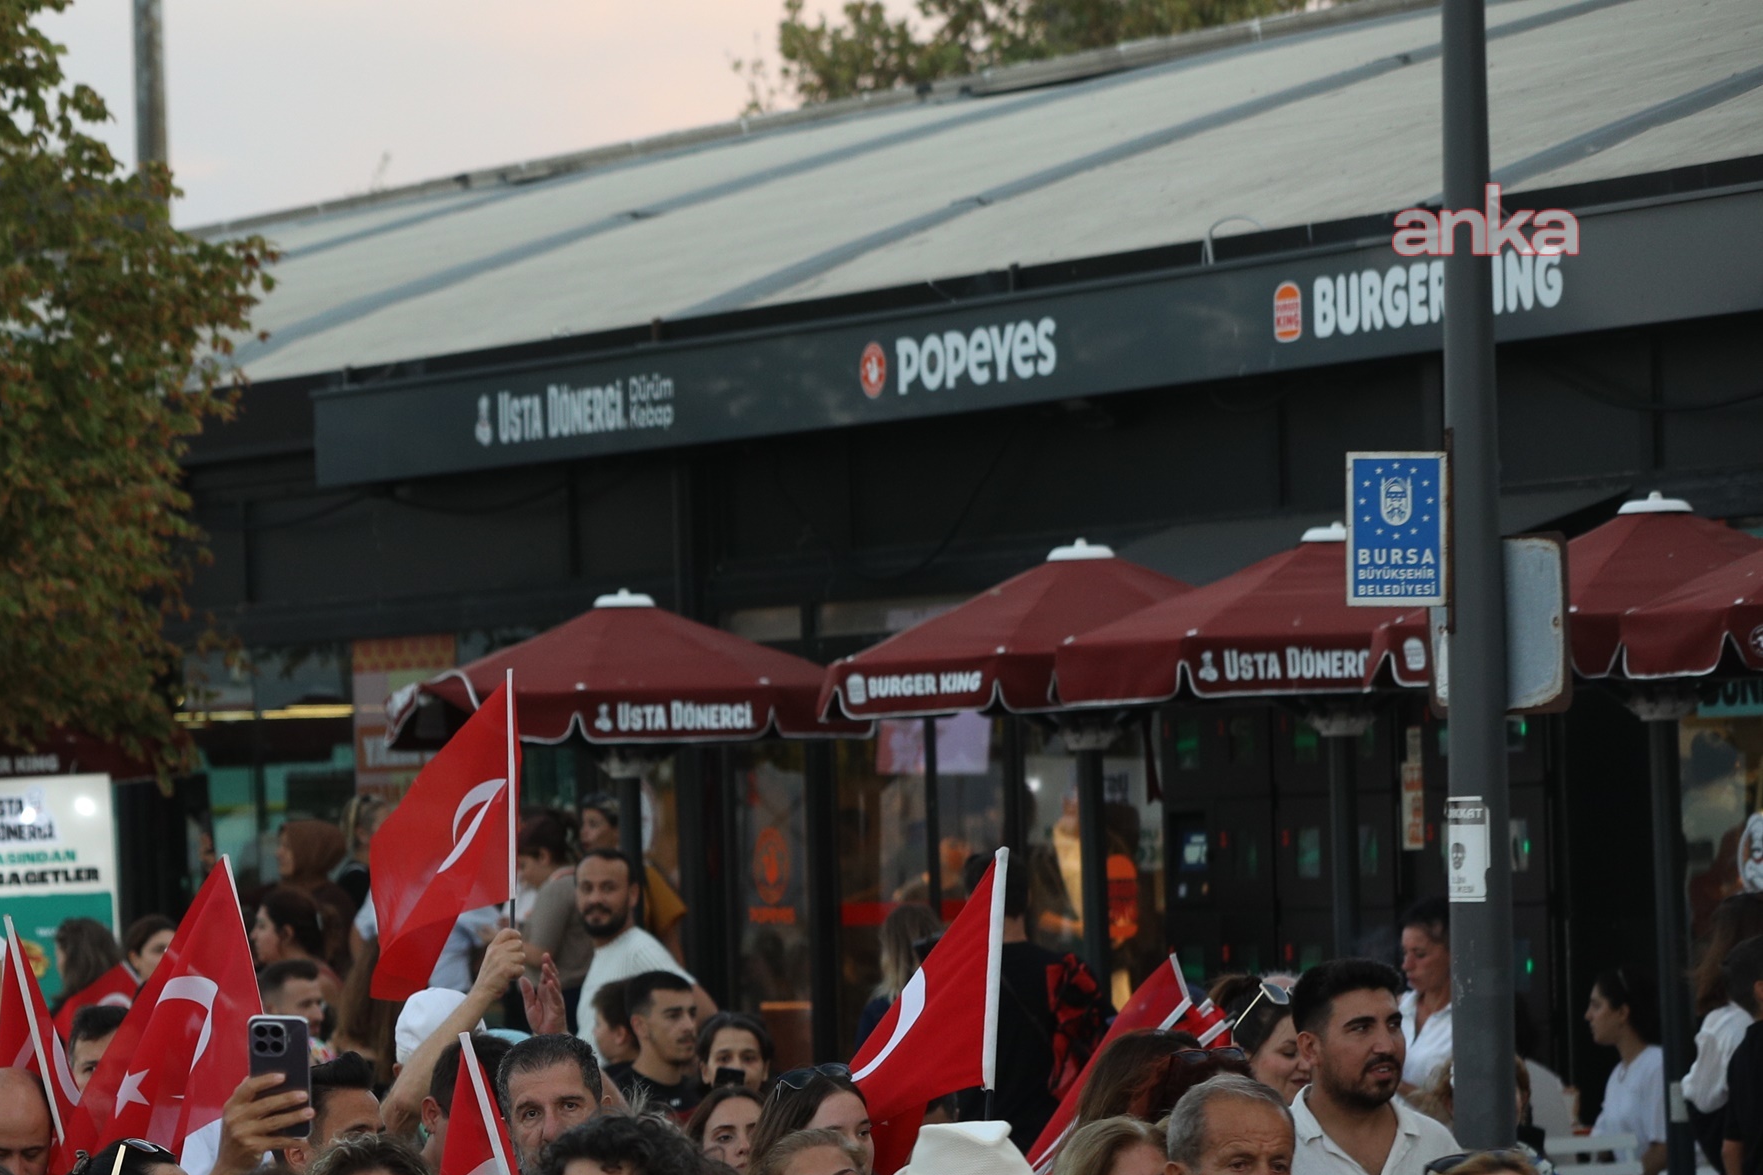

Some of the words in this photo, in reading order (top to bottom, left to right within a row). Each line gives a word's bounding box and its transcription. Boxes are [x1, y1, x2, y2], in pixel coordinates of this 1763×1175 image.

[1313, 264, 1445, 339] BURGER
[1491, 245, 1564, 316] ING
[629, 373, 674, 402] Dürüm
[498, 390, 544, 444] USTA
[629, 402, 674, 430] Kebap
[1358, 548, 1435, 565] BURSA
[1358, 565, 1435, 581] BÜYÜKŞEHİR
[1358, 581, 1435, 596] BELEDİYESİ
[1223, 648, 1282, 681] USTA
[868, 673, 937, 699] BURGER
[940, 670, 982, 694] KING
[617, 702, 668, 732] USTA
[14, 753, 58, 773] KING
